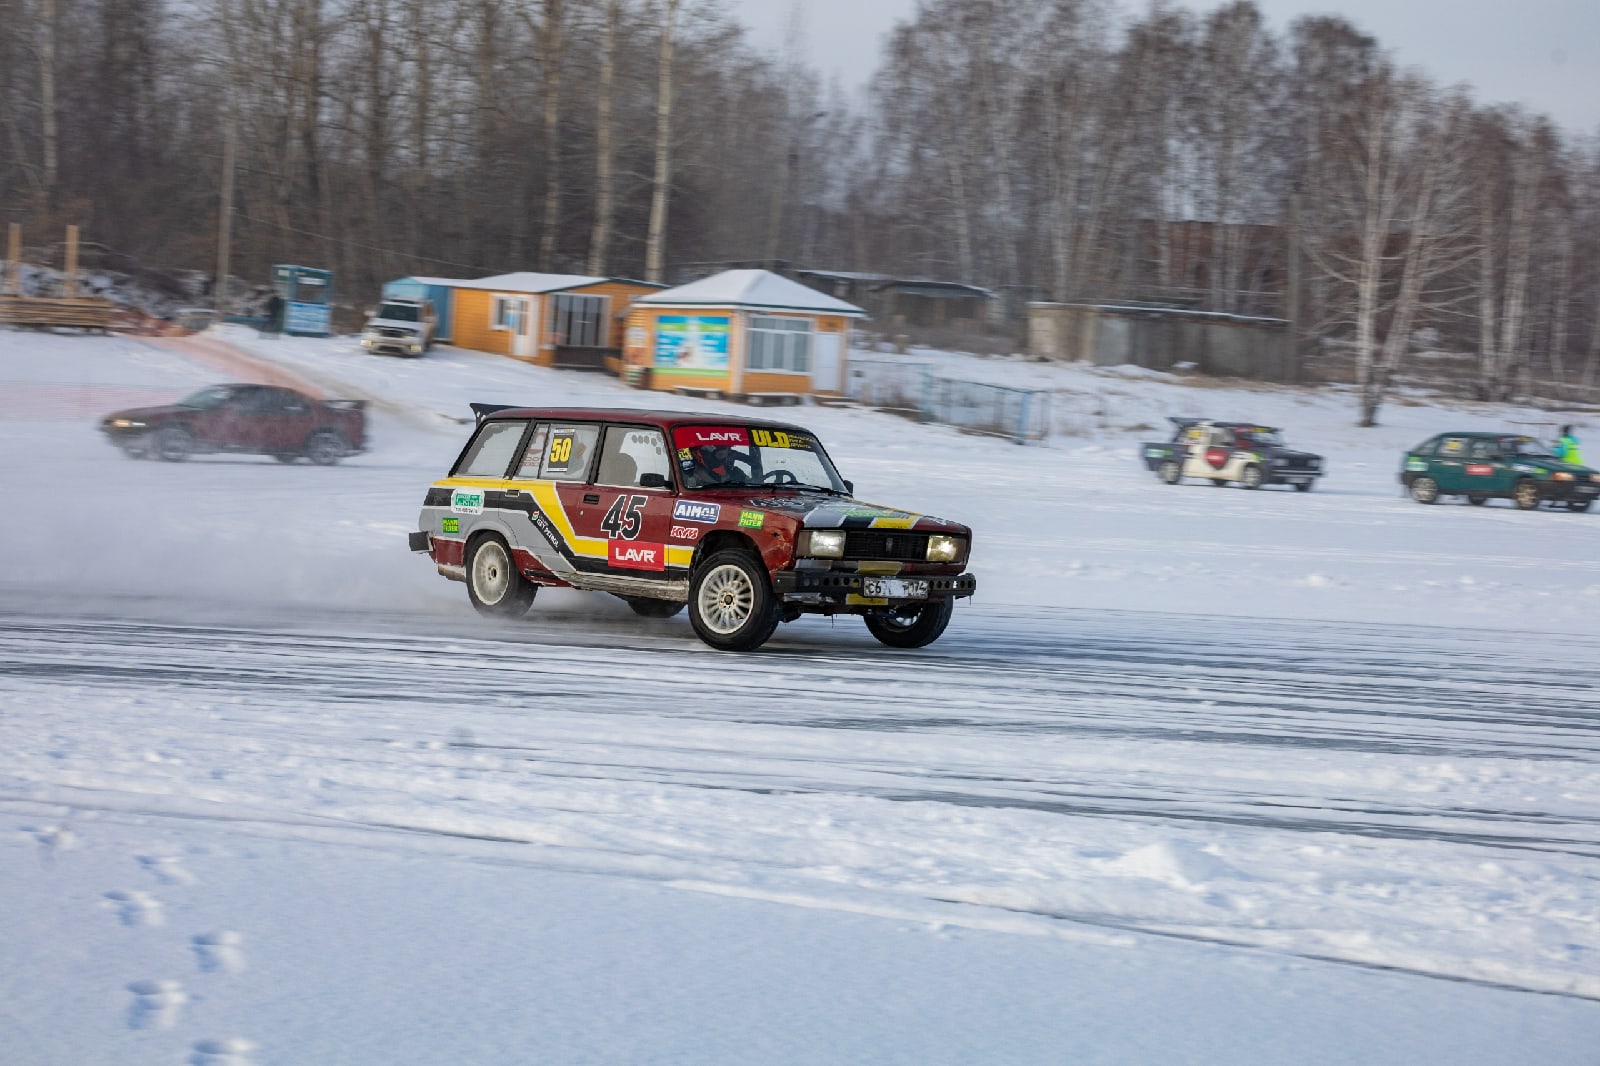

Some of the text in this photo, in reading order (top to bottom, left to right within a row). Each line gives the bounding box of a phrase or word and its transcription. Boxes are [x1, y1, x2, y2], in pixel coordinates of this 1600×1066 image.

[696, 432, 742, 442] LAVR
[751, 430, 790, 448] ULD
[550, 437, 572, 463] 50
[600, 494, 648, 541] 45
[675, 504, 717, 518] AIMOL
[741, 511, 764, 520] MANN
[739, 518, 763, 527] FILTER
[669, 525, 699, 540] KYB
[615, 547, 656, 563] LAVR
